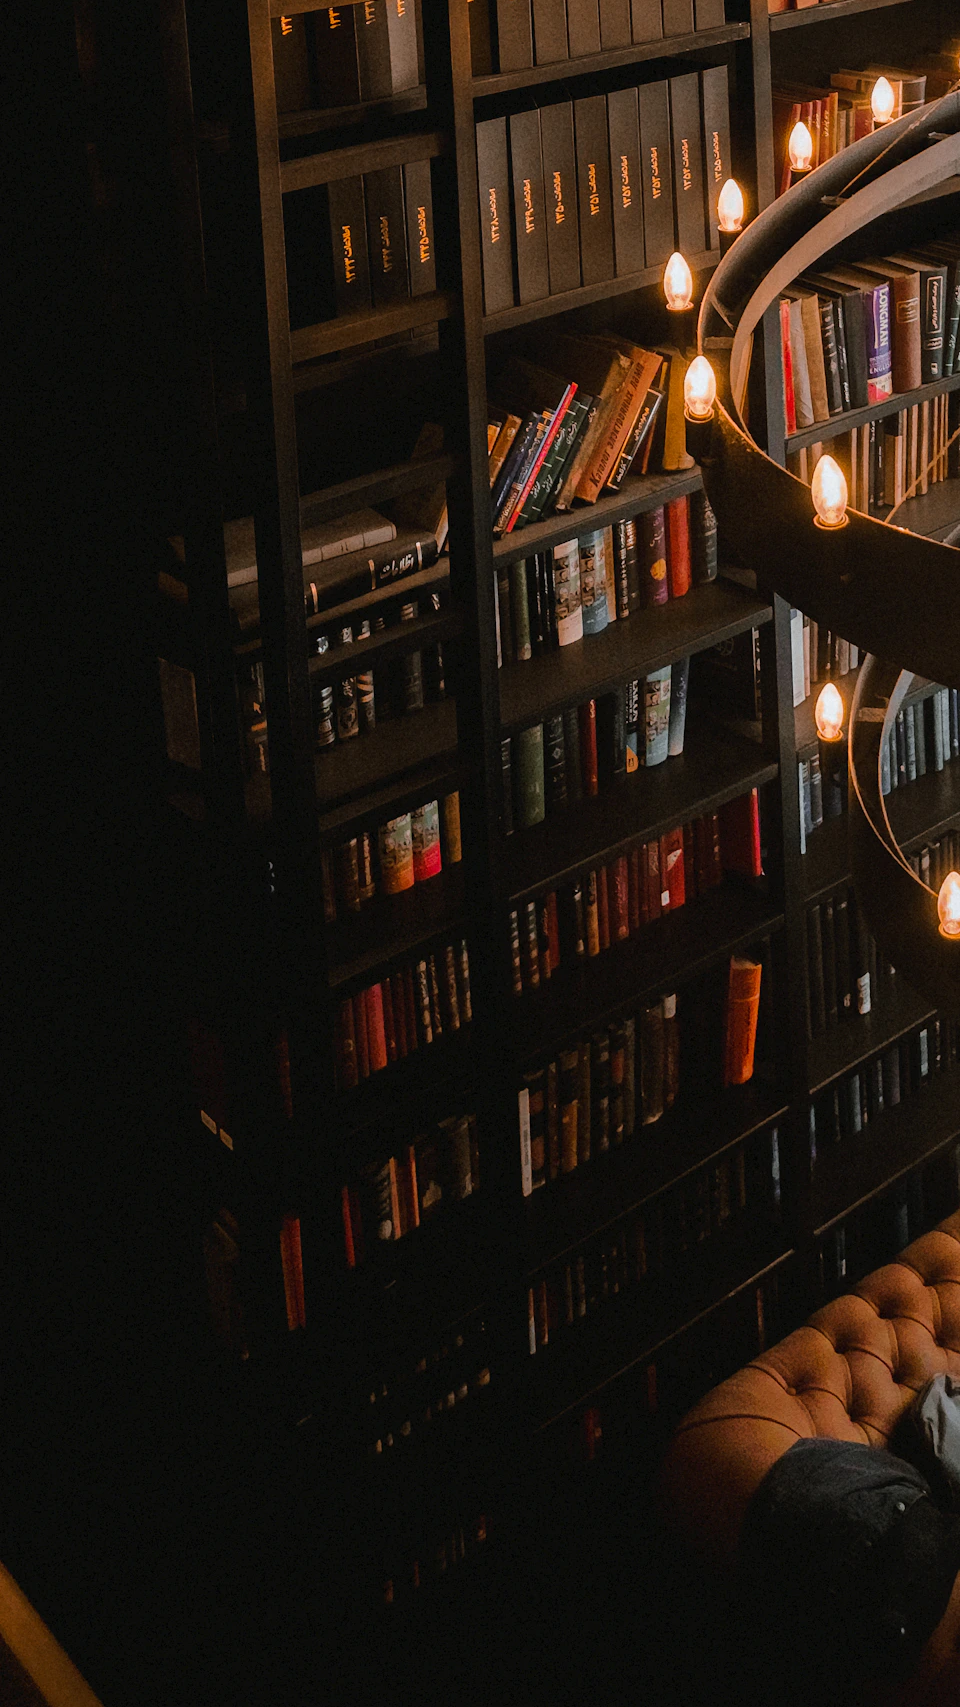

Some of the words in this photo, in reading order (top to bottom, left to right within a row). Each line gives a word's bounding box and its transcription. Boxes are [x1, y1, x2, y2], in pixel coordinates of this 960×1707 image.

[523, 179, 533, 208] اطلاعات
[553, 172, 562, 201] اطلاعات
[588, 164, 596, 193] اطلاعات
[489, 188, 498, 218] اطلاعات
[380, 216, 390, 246] اطلاعات
[418, 207, 428, 237] اطلاعات
[342, 225, 352, 256] اطلاعات
[878, 286, 890, 347] LONGMAN
